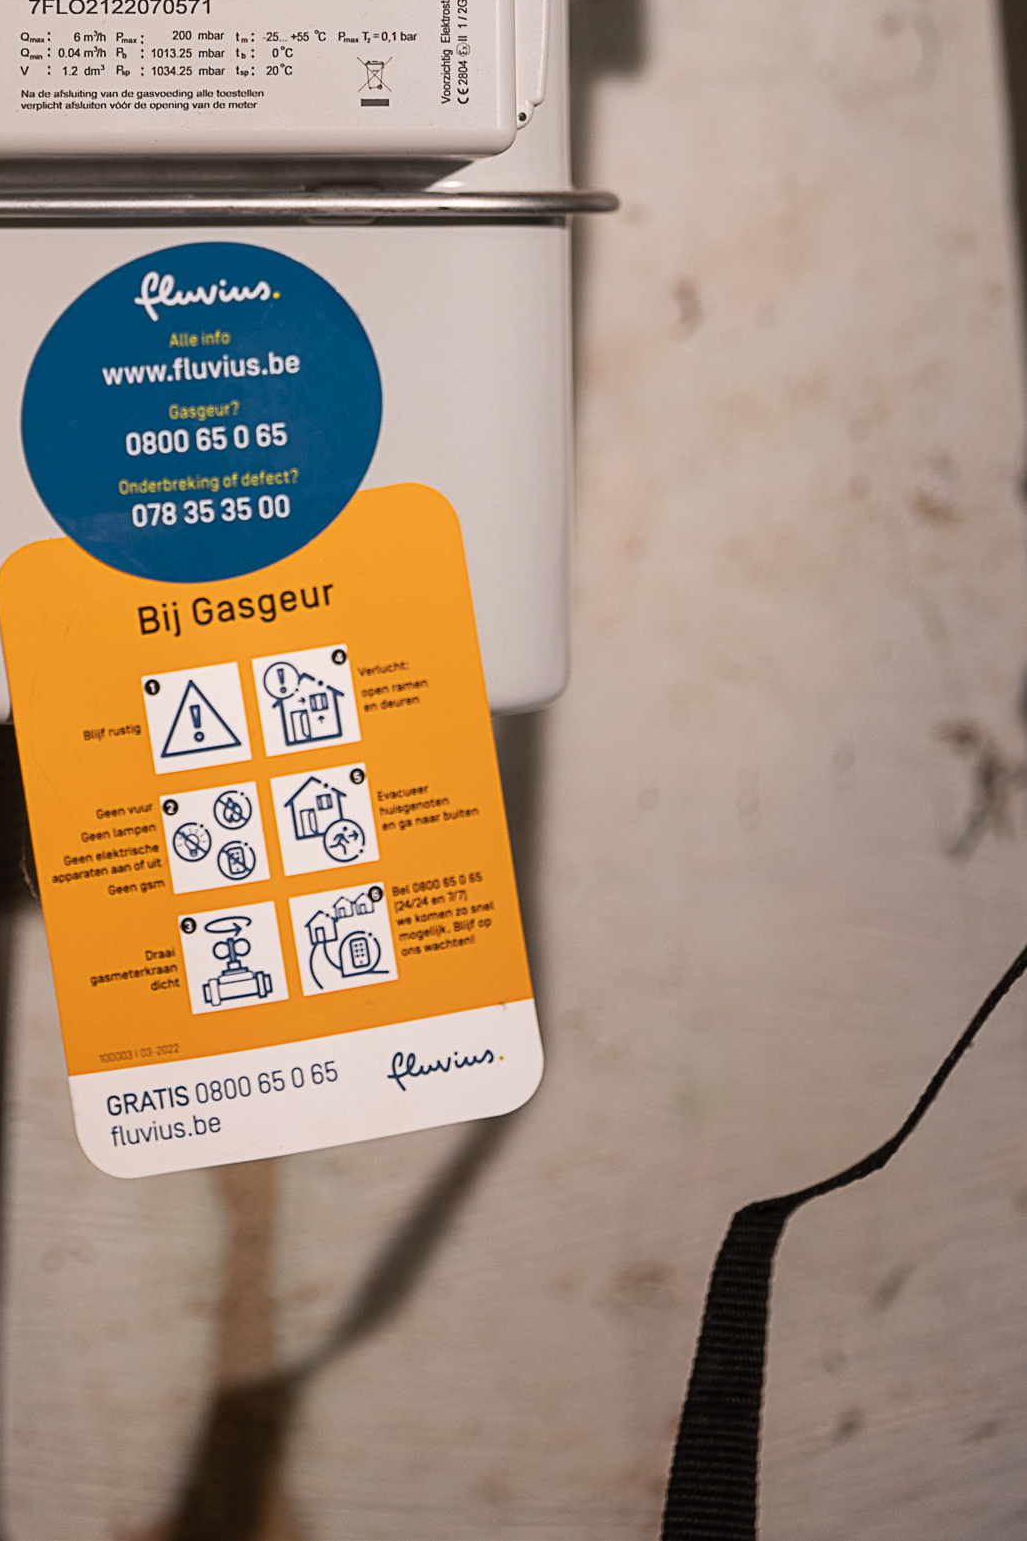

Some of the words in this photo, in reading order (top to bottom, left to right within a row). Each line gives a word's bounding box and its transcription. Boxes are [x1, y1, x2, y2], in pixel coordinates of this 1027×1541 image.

[29, 0, 211, 15] 7FLO2122070571
[73, 32, 81, 42] 6
[172, 30, 192, 41] 200
[198, 30, 224, 41] mbar
[400, 32, 417, 42] bar
[58, 48, 81, 58] 0.04
[151, 48, 192, 58] 1013.25
[198, 48, 225, 58] mbar
[20, 66, 29, 76] V
[62, 66, 78, 76] 1.2
[151, 66, 192, 76] 1034.25
[198, 66, 225, 76] mbar
[441, 49, 453, 104] Voorzichtig
[458, 60, 468, 85] 2804
[21, 89, 35, 98] Na
[38, 89, 51, 98] de
[54, 89, 97, 100] afsluiting
[121, 89, 134, 98] de
[137, 89, 193, 100] gasvoeding
[196, 89, 213, 98] alle
[216, 89, 264, 98] toestellen
[21, 101, 62, 111] verplicht
[65, 101, 107, 110] afsluiten
[134, 101, 147, 110] de
[149, 101, 189, 111] opening
[213, 101, 225, 110] de
[228, 102, 257, 110] meter
[168, 333, 198, 348] Alle
[202, 331, 231, 346] info
[102, 352, 300, 386] www.fluvius.be
[168, 400, 240, 422] Gasgeur?
[125, 429, 190, 456] 0800
[196, 426, 228, 452] 65
[233, 424, 250, 449] 0
[255, 422, 288, 447] 65
[118, 474, 219, 495] Onderbreking
[223, 473, 237, 488] of
[241, 469, 299, 486] defect?
[132, 503, 178, 528] 078
[183, 500, 215, 525] 35
[221, 497, 253, 522] 35
[258, 494, 291, 519] 00
[138, 602, 181, 637] Bij
[191, 584, 334, 626] Gasgeur
[361, 684, 389, 698] open
[391, 679, 429, 693] ramen
[363, 701, 378, 712] en
[380, 696, 420, 710] deuren
[83, 728, 106, 741] Blijf
[108, 724, 142, 739] rustig
[377, 785, 429, 802] Evacueer
[96, 808, 126, 820] Geen
[127, 803, 154, 816] vuur
[379, 797, 450, 817] huisgenoten
[381, 821, 397, 832] en
[399, 819, 413, 831] ga
[415, 815, 441, 827] naar
[443, 807, 480, 823] buiten
[81, 831, 111, 843] Geen
[113, 823, 157, 839] lampen
[64, 855, 93, 867] Geen
[96, 844, 160, 861] elektrische
[52, 867, 109, 885] apparaten
[111, 863, 132, 875] aan
[134, 860, 145, 871] of
[147, 858, 163, 870] uit
[108, 884, 138, 896] Geen
[140, 879, 166, 893] gsm
[391, 885, 411, 897] Bel
[412, 879, 441, 892] 0800
[431, 894, 446, 905] en
[395, 916, 413, 926] we
[414, 909, 454, 923] komen
[455, 906, 469, 917] zo
[471, 900, 495, 914] snel
[453, 918, 475, 933] Blijf
[477, 917, 493, 929] op
[145, 947, 176, 961] Draai
[401, 945, 421, 957] ons
[423, 935, 475, 952] wachten!
[90, 964, 178, 987] gasmeterkraan
[150, 978, 181, 991] dicht
[106, 1085, 190, 1117] GRATIS
[195, 1075, 252, 1105] 0800
[258, 1068, 286, 1094] 65
[291, 1065, 305, 1088] 0
[311, 1060, 339, 1085] 65
[111, 1114, 222, 1147] fluvius.be
